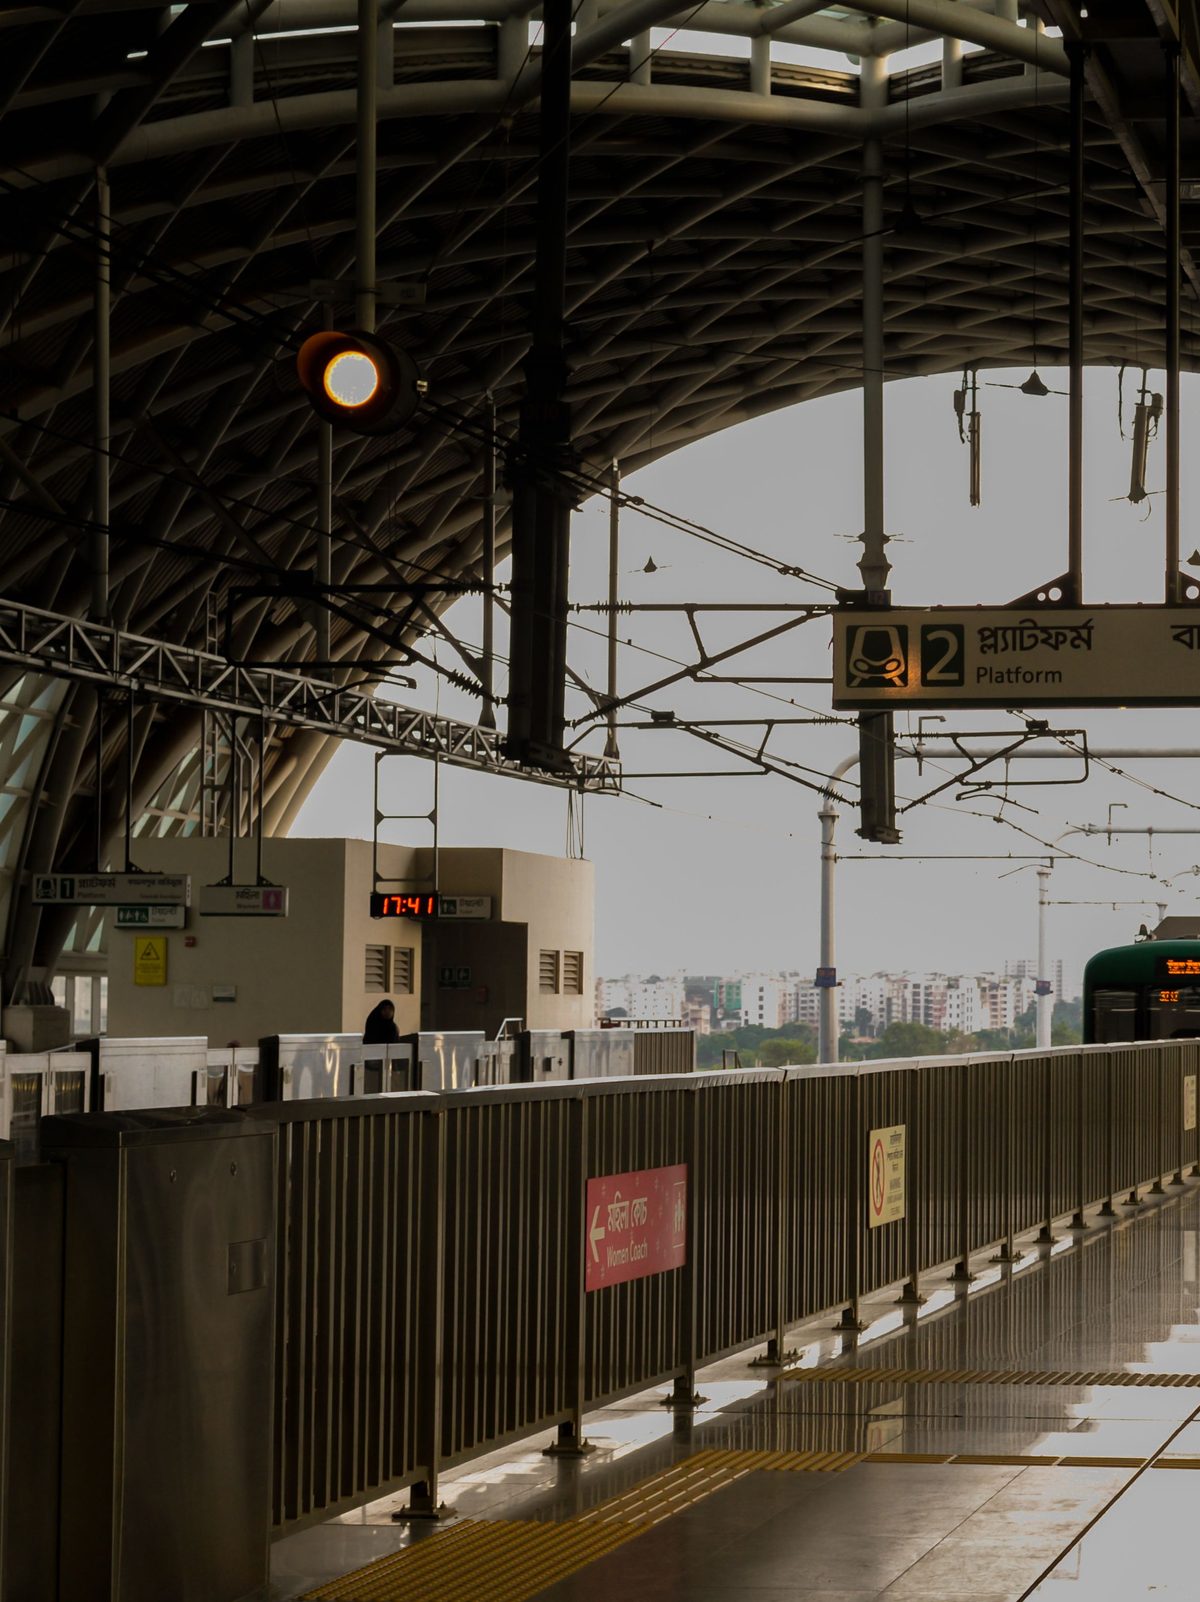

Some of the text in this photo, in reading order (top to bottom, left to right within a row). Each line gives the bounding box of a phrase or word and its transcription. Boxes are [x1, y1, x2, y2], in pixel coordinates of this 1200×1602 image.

[977, 618, 1095, 655] প্ল্যাটফর্ম
[923, 629, 960, 681] 2
[976, 665, 1063, 686] Platform
[62, 880, 71, 898] 1
[382, 896, 434, 915] 17:41
[607, 1190, 648, 1232] মহিলা কোচ
[607, 1238, 648, 1268] Women Coach
